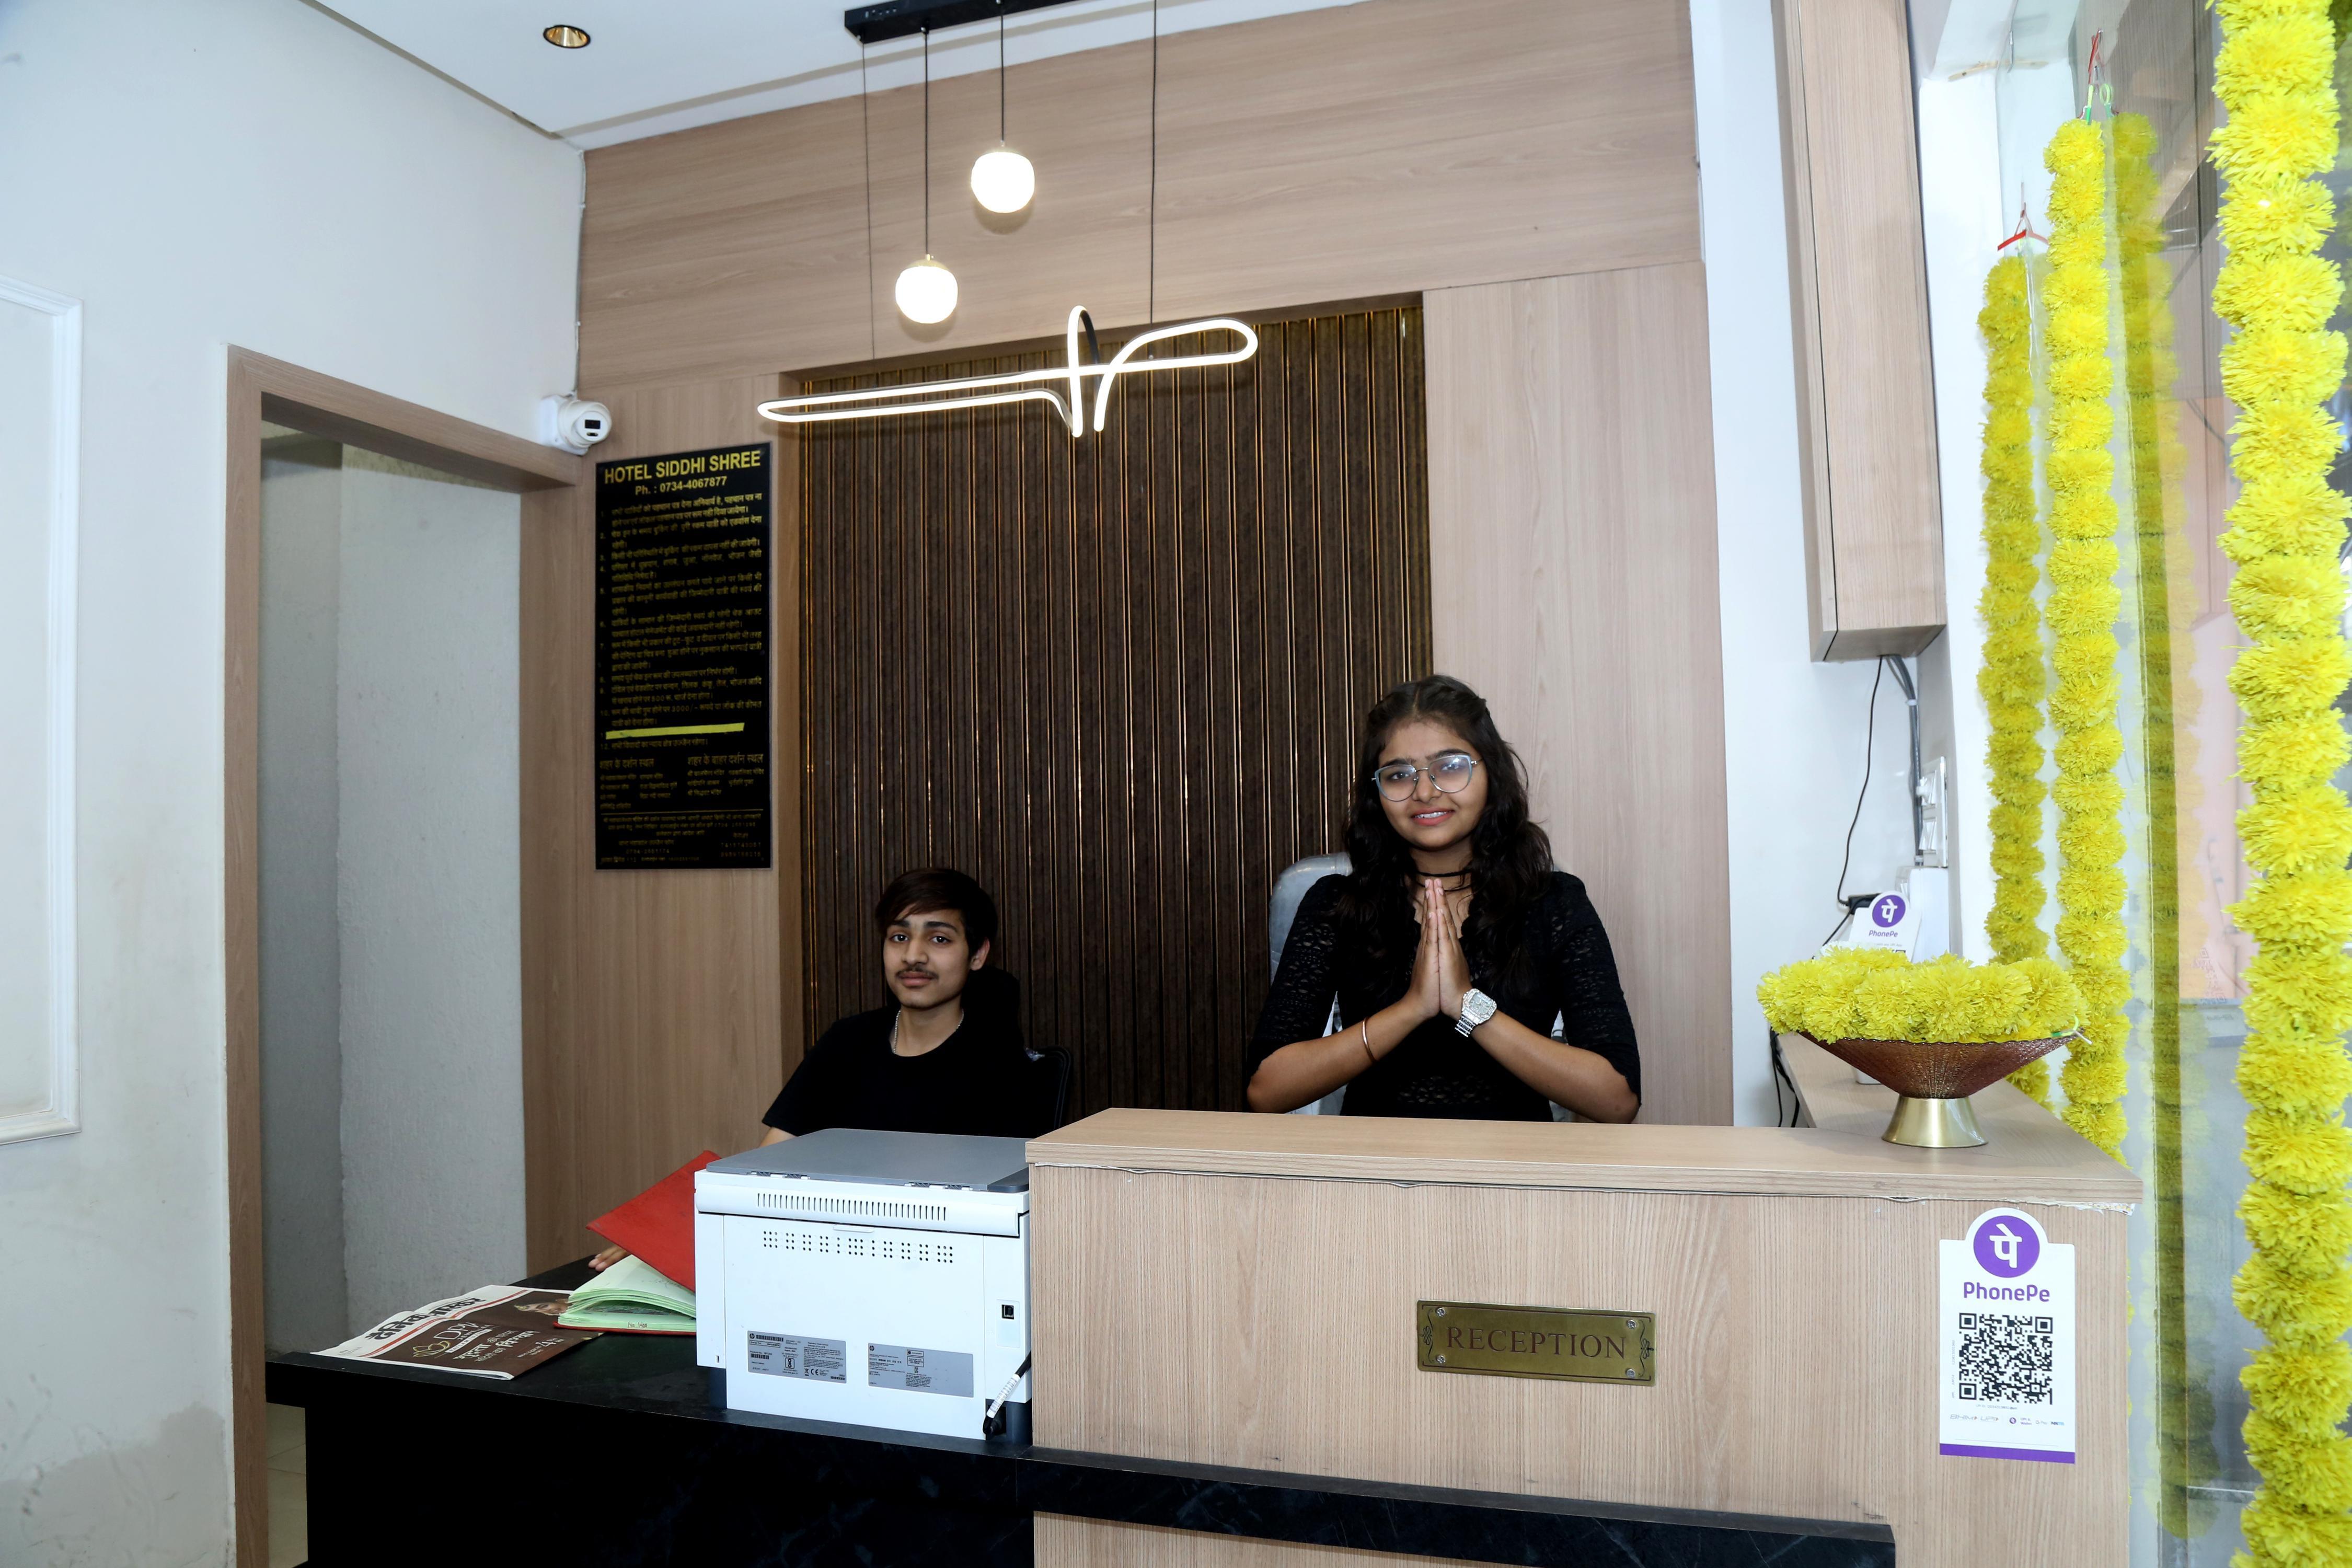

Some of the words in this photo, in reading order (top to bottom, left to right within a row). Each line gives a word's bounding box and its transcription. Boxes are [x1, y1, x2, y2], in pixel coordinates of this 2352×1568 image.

[605, 464, 652, 484] HOTEL
[656, 457, 705, 478] SIDDHI
[709, 451, 761, 471] SHREE
[635, 486, 651, 495] Ph.
[660, 476, 728, 492] 0734-4067877
[622, 756, 638, 769] दर्शन
[639, 758, 655, 768] स्थल
[687, 756, 702, 767] शहर
[703, 753, 710, 766] के
[711, 755, 728, 766] बाहर
[729, 751, 745, 766] दर्शन
[747, 753, 764, 764] स्थल
[1964, 1282, 2050, 1302] PhonePe
[365, 1314, 429, 1340] दैनिक
[1447, 1327, 1627, 1359] RECEPTION
